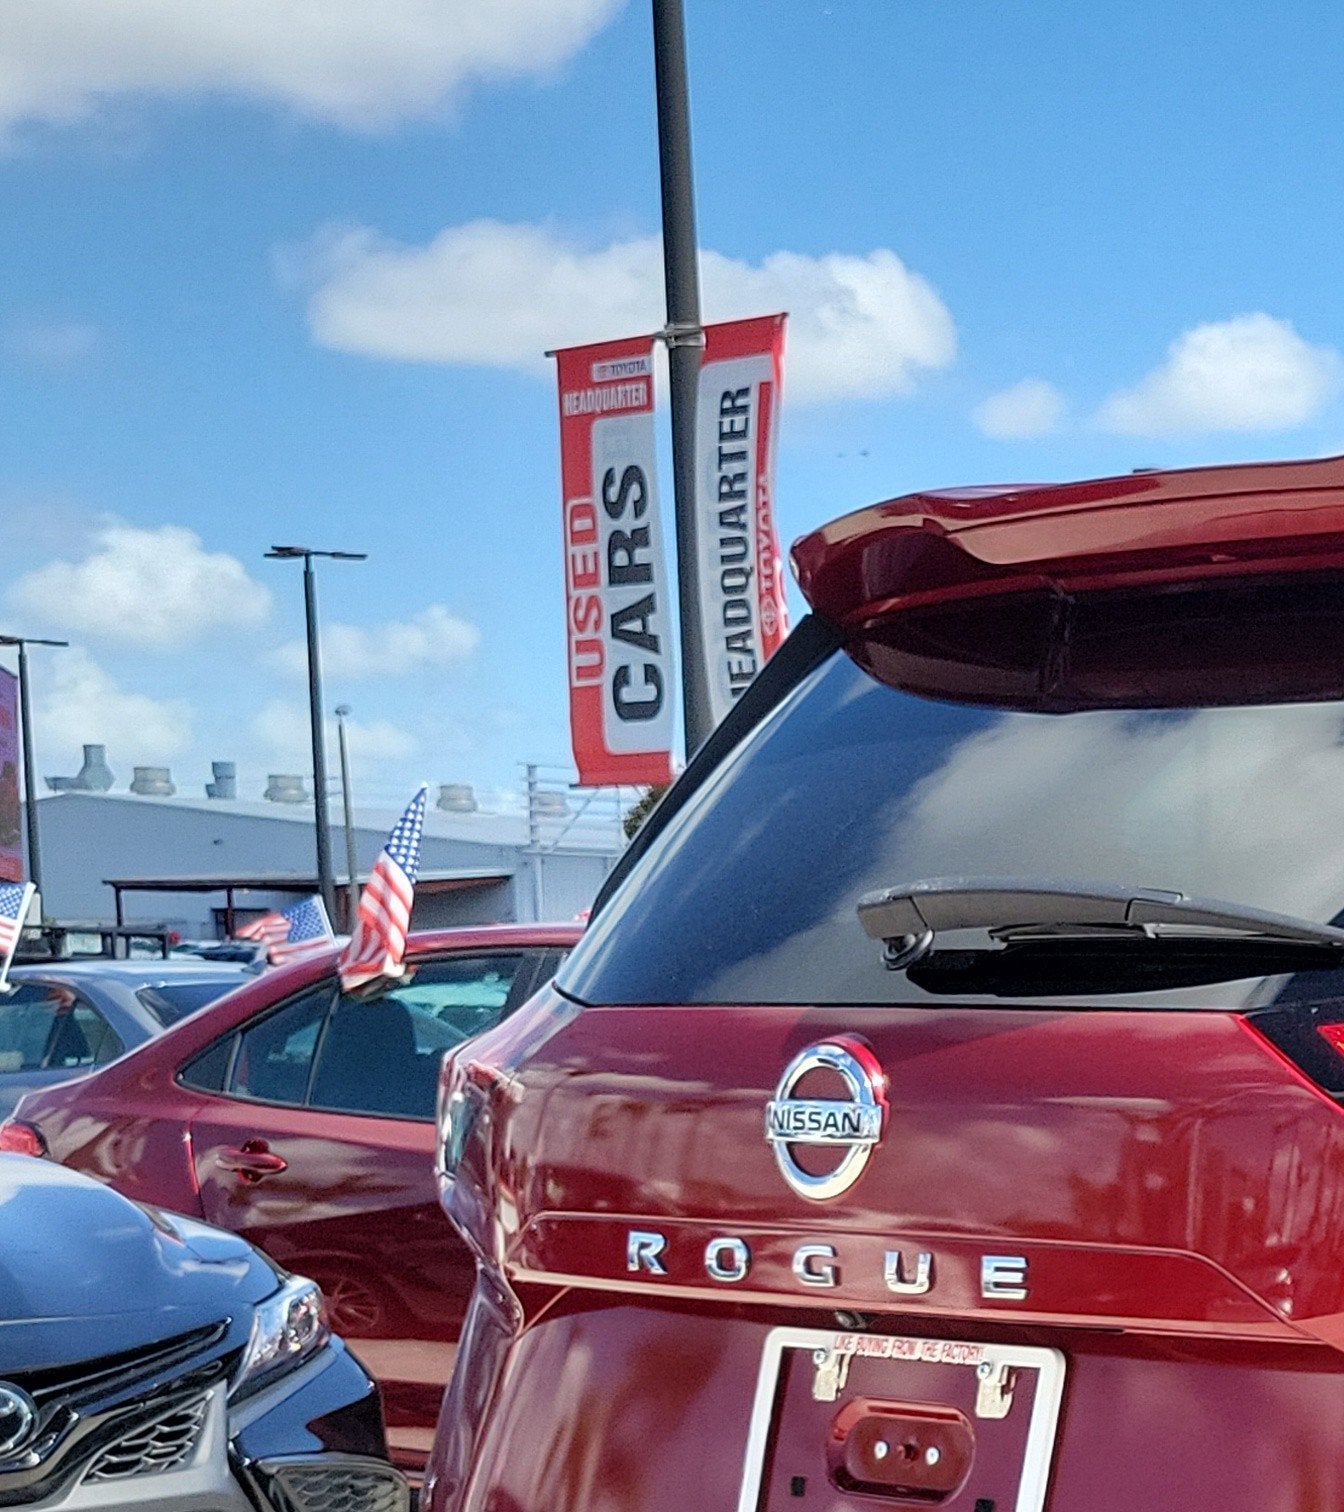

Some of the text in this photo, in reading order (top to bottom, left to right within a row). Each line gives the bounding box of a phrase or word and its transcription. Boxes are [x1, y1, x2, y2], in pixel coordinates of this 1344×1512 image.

[562, 382, 647, 415] HEADQUARTER
[610, 359, 647, 375] TOYOTA
[718, 386, 756, 698] EADQUARTER
[569, 501, 607, 683] USED
[602, 464, 666, 723] CARS
[769, 1104, 862, 1134] NISSAN
[626, 1230, 1029, 1300] ROGUE
